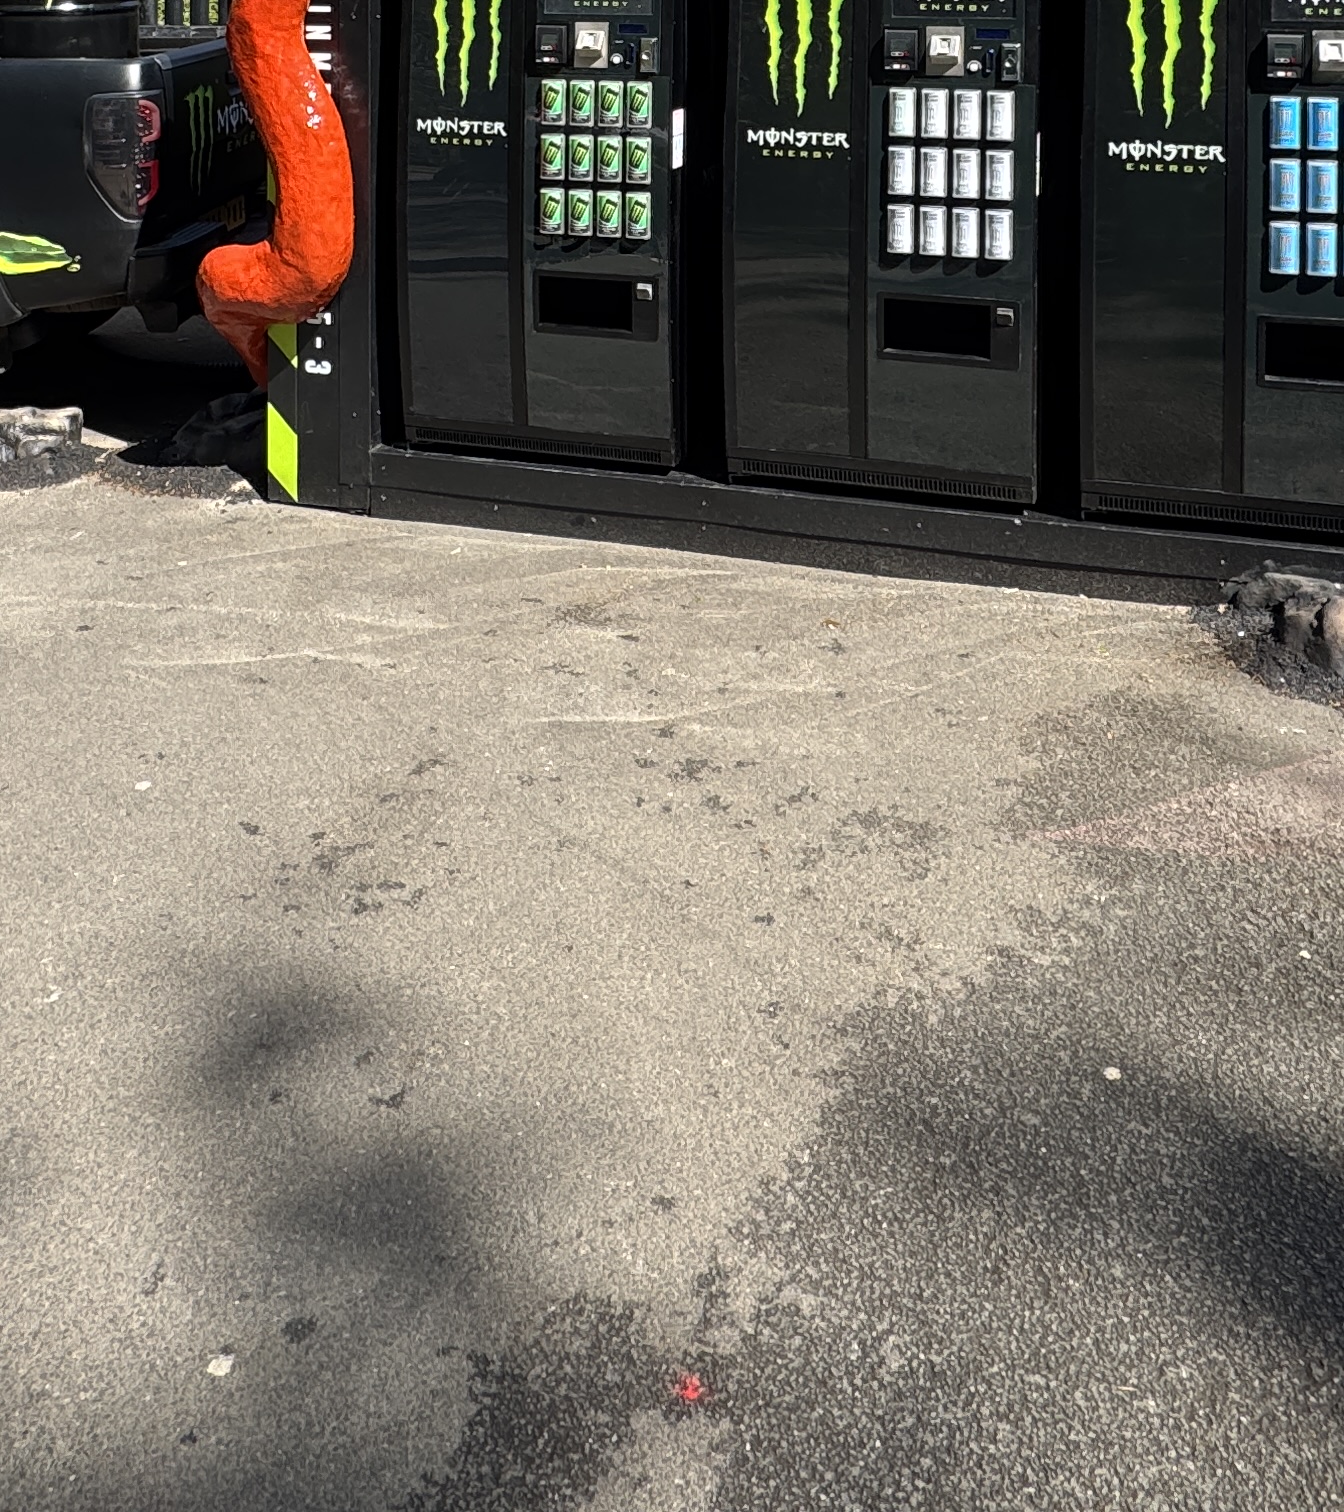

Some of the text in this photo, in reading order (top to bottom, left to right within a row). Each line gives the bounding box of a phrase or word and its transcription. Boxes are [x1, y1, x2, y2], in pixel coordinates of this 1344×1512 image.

[919, 3, 990, 13] ENERGY
[416, 116, 507, 137] MONSTER
[430, 137, 494, 147] ENERGY
[746, 127, 850, 149] MONSTER
[762, 148, 835, 160] ENERGY
[1107, 139, 1227, 163] MONSTER
[1125, 162, 1209, 174] ENERGY
